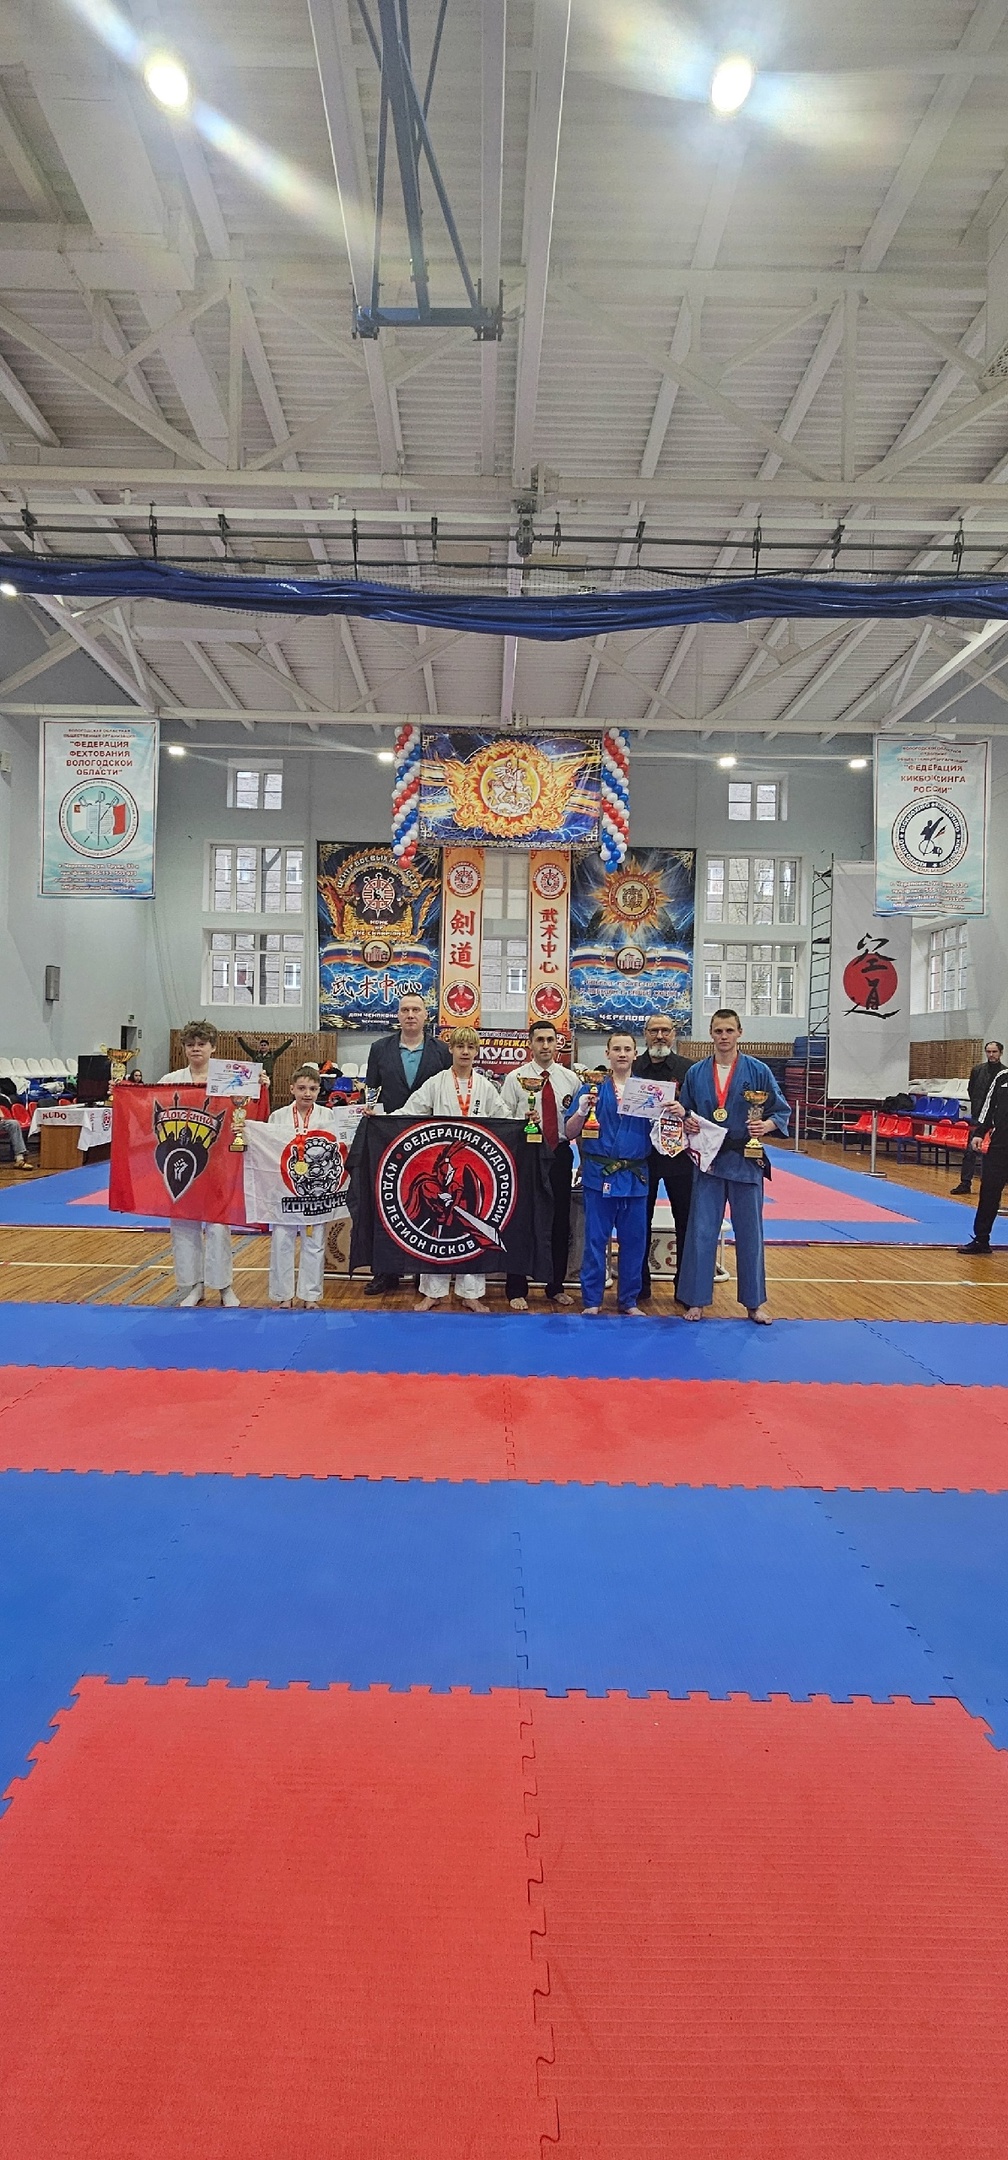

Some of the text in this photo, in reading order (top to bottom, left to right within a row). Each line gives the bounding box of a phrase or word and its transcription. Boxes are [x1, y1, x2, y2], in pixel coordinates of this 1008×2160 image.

[901, 774, 966, 783] КИКБОКСИНГА
[337, 864, 354, 889] ЦЕНТР
[354, 855, 388, 867] БОЕВЫХ
[389, 858, 419, 889] ИСССТВ
[448, 909, 476, 969] 剣道
[538, 908, 559, 974] 武术中心
[479, 1046, 527, 1061] КУДО
[42, 1111, 67, 1120] KUDO
[403, 1128, 510, 1223] ФЕДЕРАЦИЯ КУДО РОССИИ
[382, 1162, 476, 1255] КУДО ЛЕГИОН ПСКОВ
